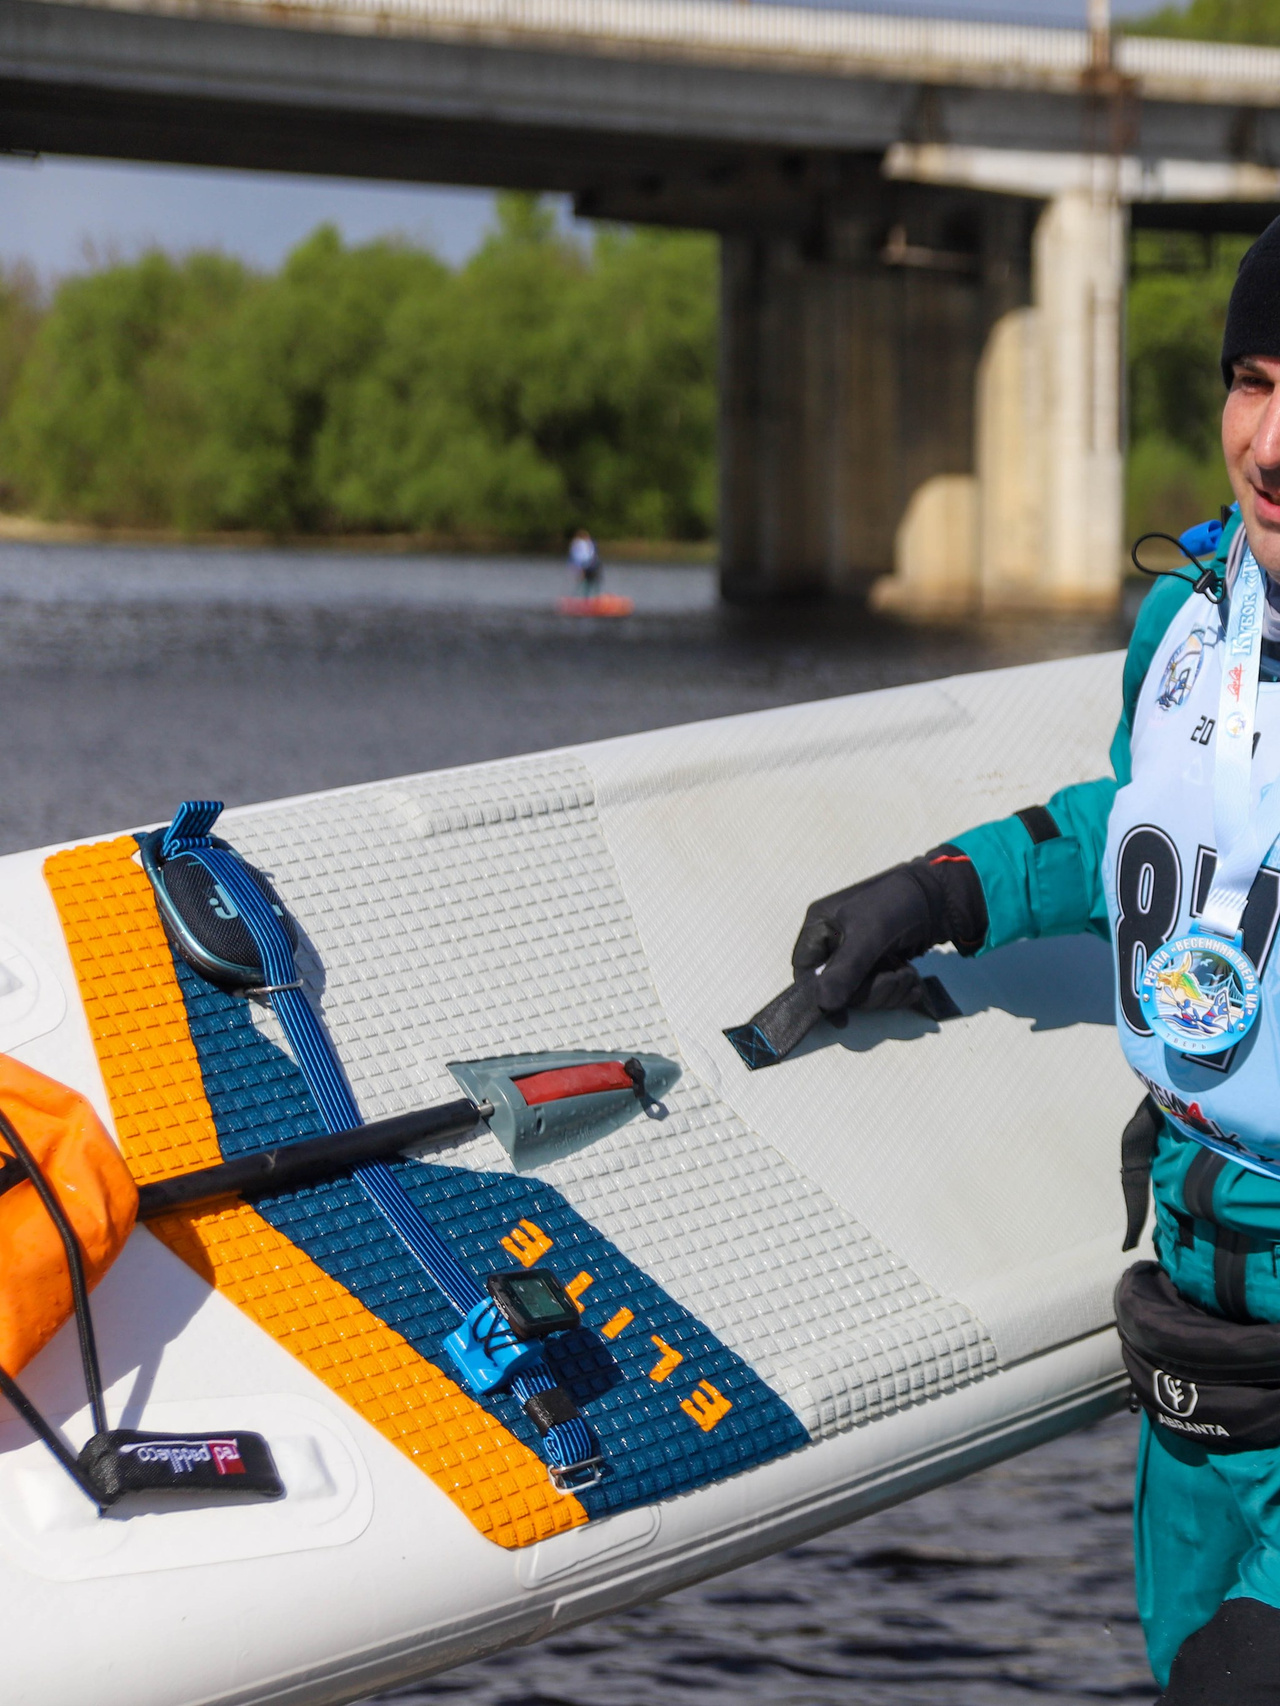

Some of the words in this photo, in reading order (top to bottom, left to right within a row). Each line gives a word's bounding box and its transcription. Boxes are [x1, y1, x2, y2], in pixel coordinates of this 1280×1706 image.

[1144, 950, 1170, 986] РЕГАТА
[1166, 1033, 1207, 1050] ТВЕРЬ
[1158, 1413, 1231, 1437] ABRANTA
[213, 1446, 241, 1475] red
